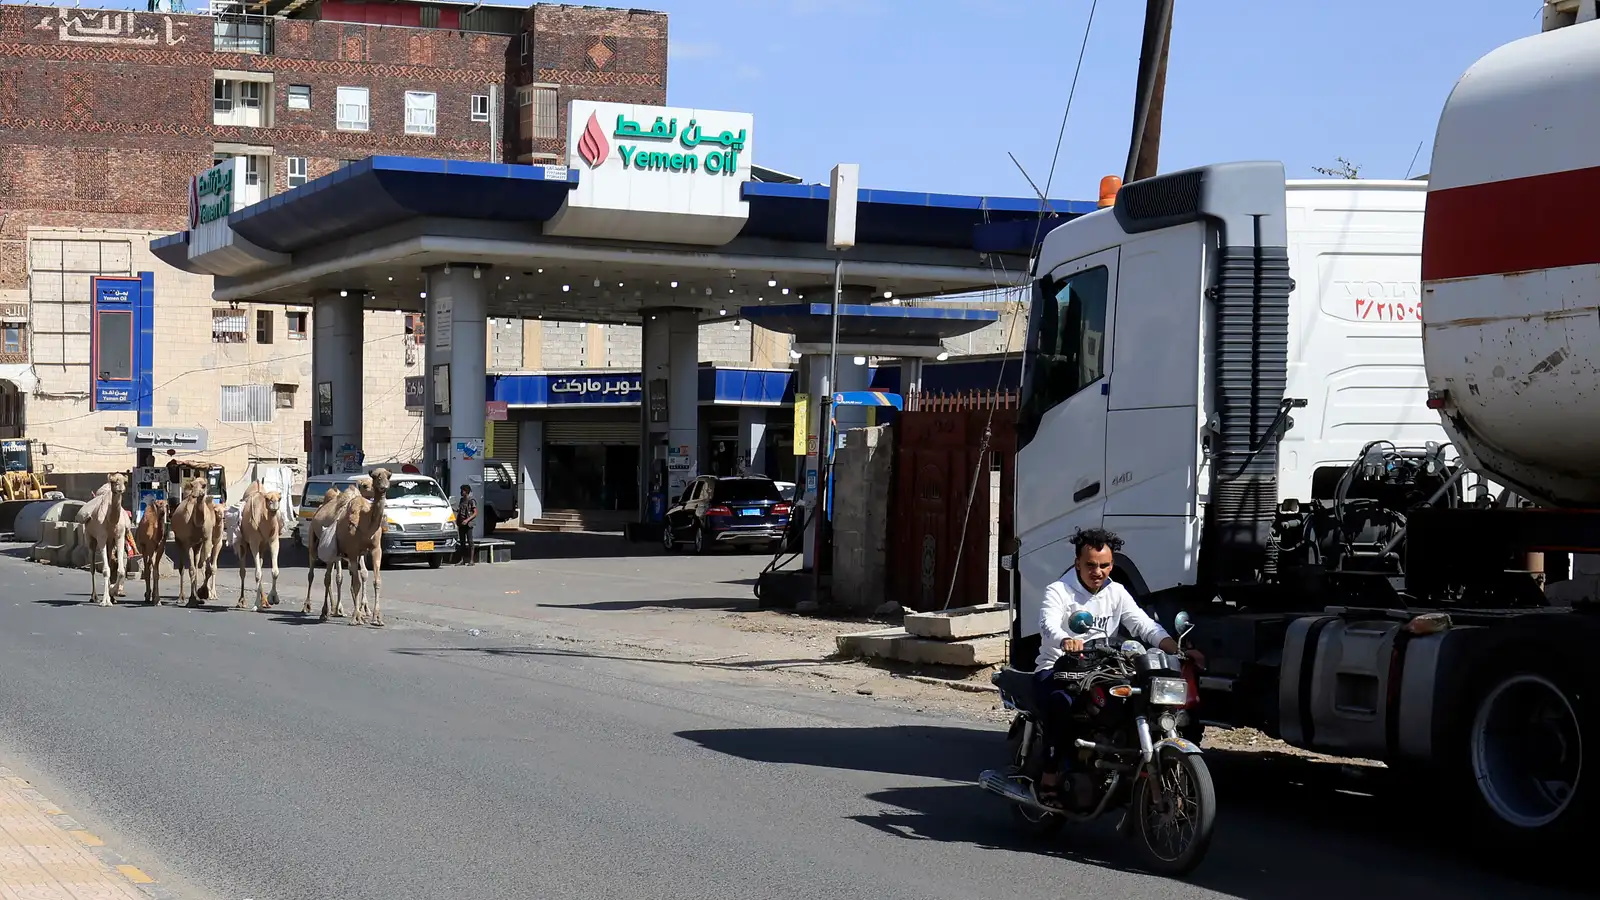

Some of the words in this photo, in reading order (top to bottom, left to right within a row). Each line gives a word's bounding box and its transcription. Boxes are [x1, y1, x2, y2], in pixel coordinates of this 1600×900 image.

[613, 114, 677, 140] نفط
[679, 118, 746, 150] يمن
[618, 145, 698, 170] Yemen
[705, 150, 737, 173] Oil
[200, 203, 220, 224] Yemen
[219, 194, 230, 217] Oil
[1333, 281, 1420, 298] VOLV
[552, 378, 602, 395] ماركت
[1112, 471, 1133, 486] 440
